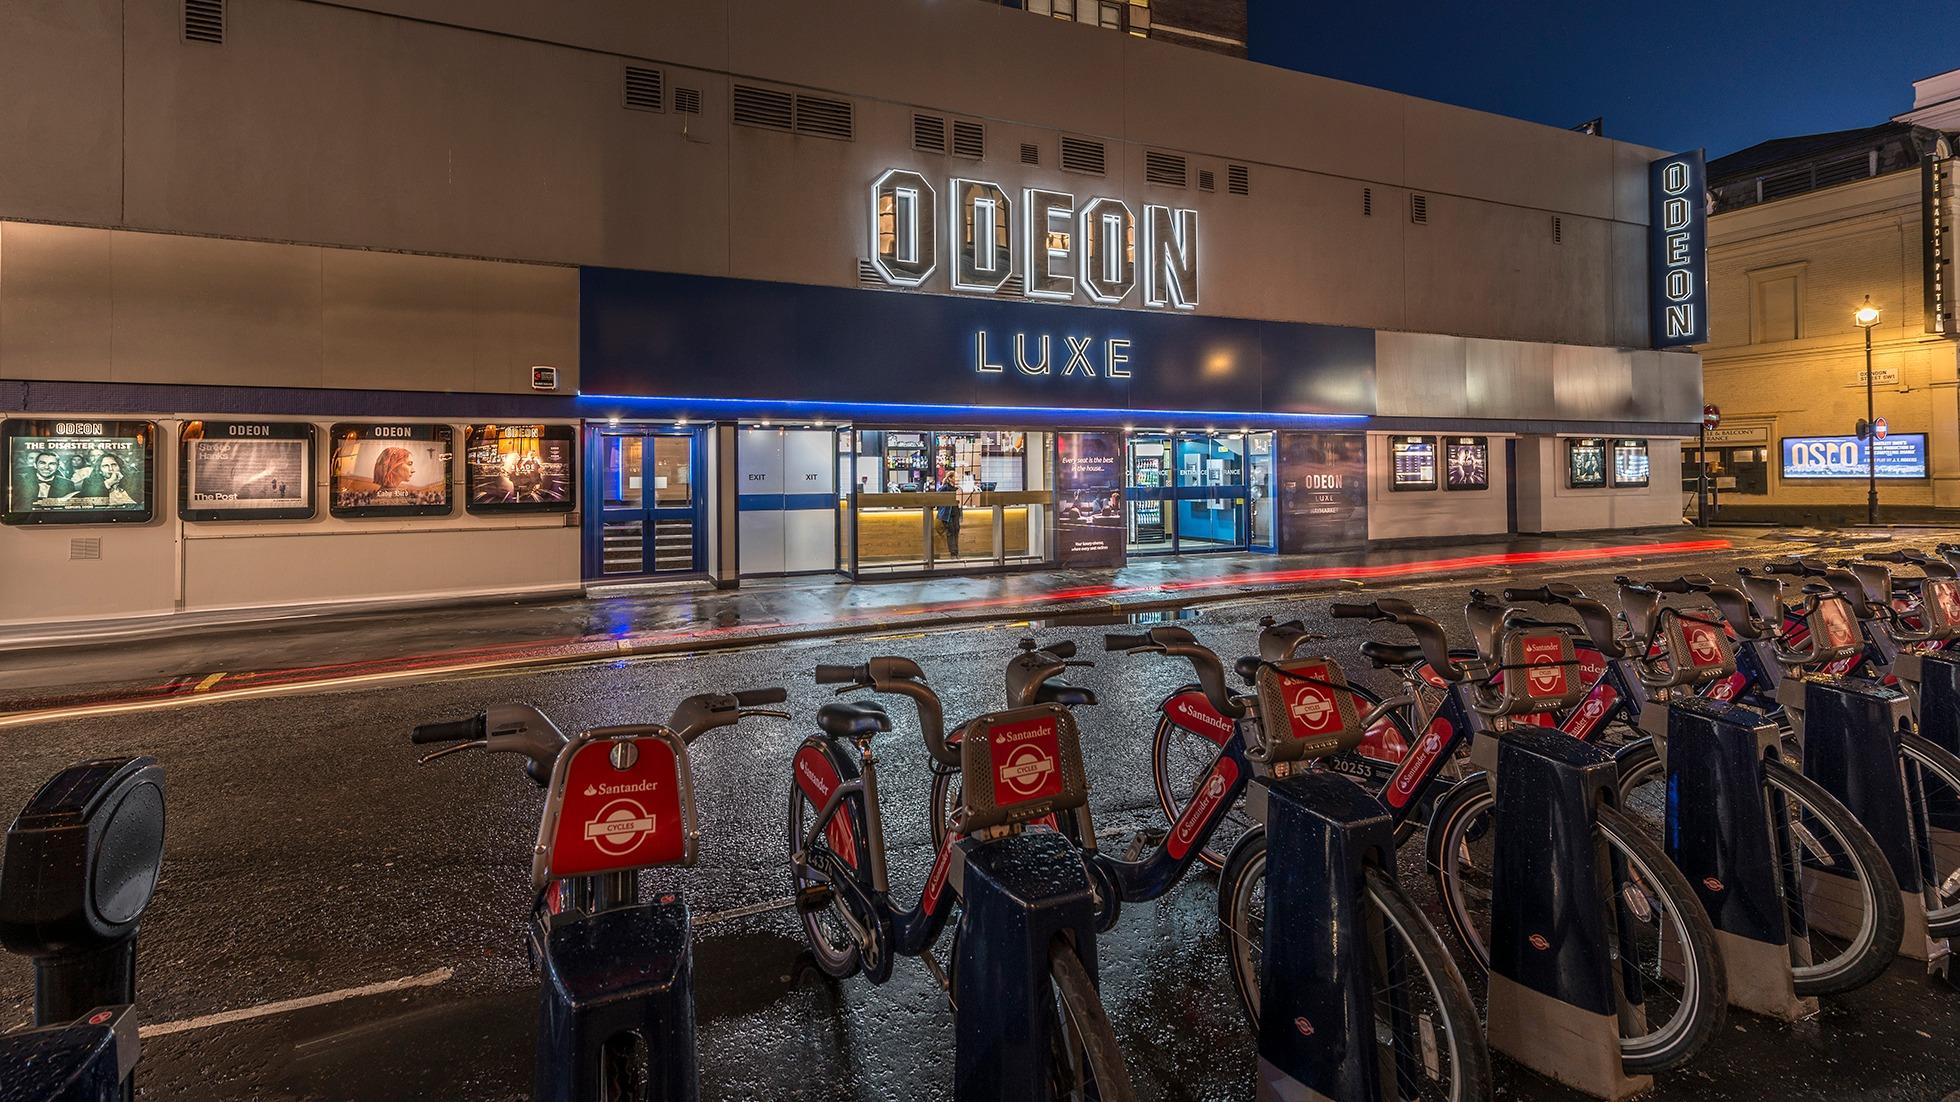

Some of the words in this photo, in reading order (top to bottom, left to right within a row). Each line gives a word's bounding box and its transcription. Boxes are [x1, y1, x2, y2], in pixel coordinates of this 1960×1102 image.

[870, 168, 1200, 310] ODEON
[1663, 161, 1694, 338] ODEON
[974, 331, 1132, 378] LUXE
[55, 422, 103, 435] ODEON
[229, 425, 270, 436] ODEON
[375, 427, 412, 437] ODEON
[504, 427, 539, 438] ODEON
[24, 442, 45, 450] THE
[48, 442, 94, 450] DISASTER
[97, 442, 133, 450] ARTIST
[1062, 457, 1075, 465] Every
[1306, 474, 1343, 489] ODEON
[195, 493, 213, 501] The
[215, 492, 238, 501] Post
[1531, 643, 1559, 652] Santander
[1187, 705, 1232, 733] Santander
[1006, 725, 1052, 742] Santander
[1017, 765, 1038, 774] CYCLES
[1333, 759, 1372, 777] 20253
[1404, 753, 1427, 783] Santander
[804, 762, 829, 796] Santander
[599, 779, 658, 795] Santander
[1186, 797, 1210, 831] Santander
[607, 822, 635, 831] CYCLES
